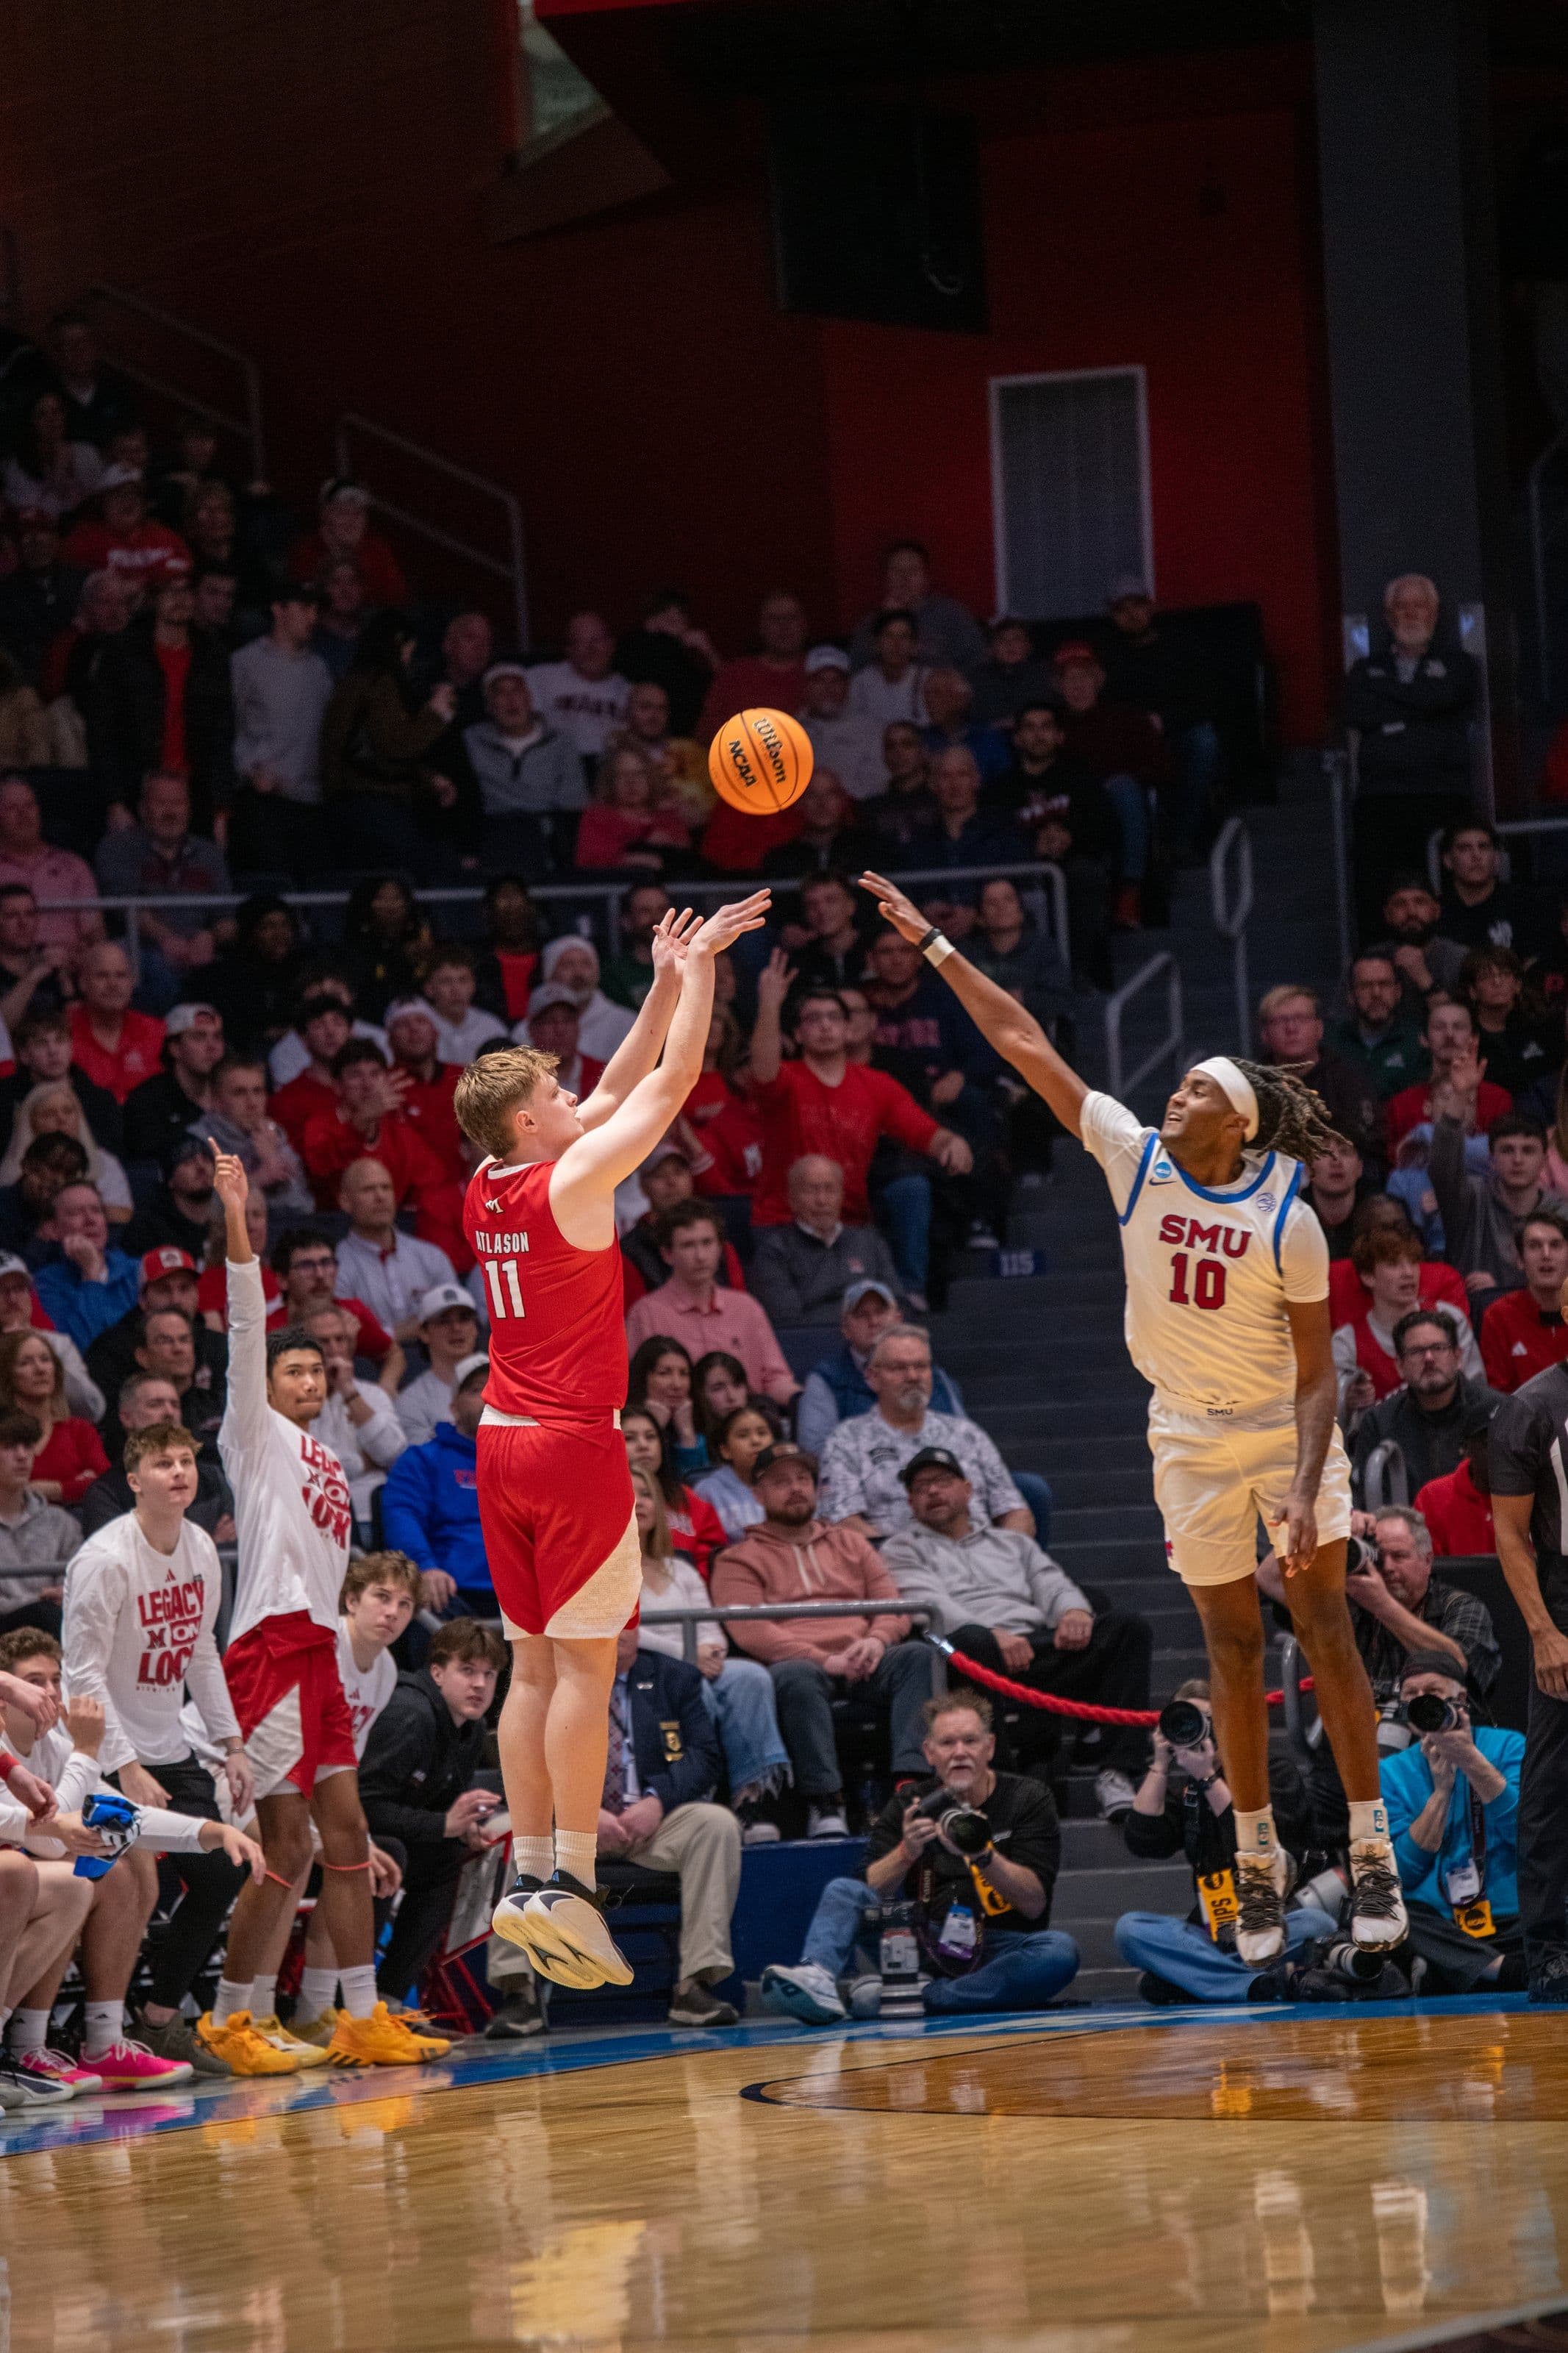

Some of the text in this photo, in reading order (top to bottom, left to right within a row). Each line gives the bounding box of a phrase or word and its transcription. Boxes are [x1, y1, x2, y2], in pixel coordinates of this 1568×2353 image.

[728, 740, 757, 788] NCAA
[752, 718, 787, 784] Wilson
[475, 1230, 529, 1254] ATLASON
[1159, 1214, 1253, 1258] SMU
[484, 1259, 526, 1318] 11
[1170, 1252, 1227, 1310] 10
[1206, 1407, 1233, 1416] SMU
[137, 1580, 205, 1627] LEGACY
